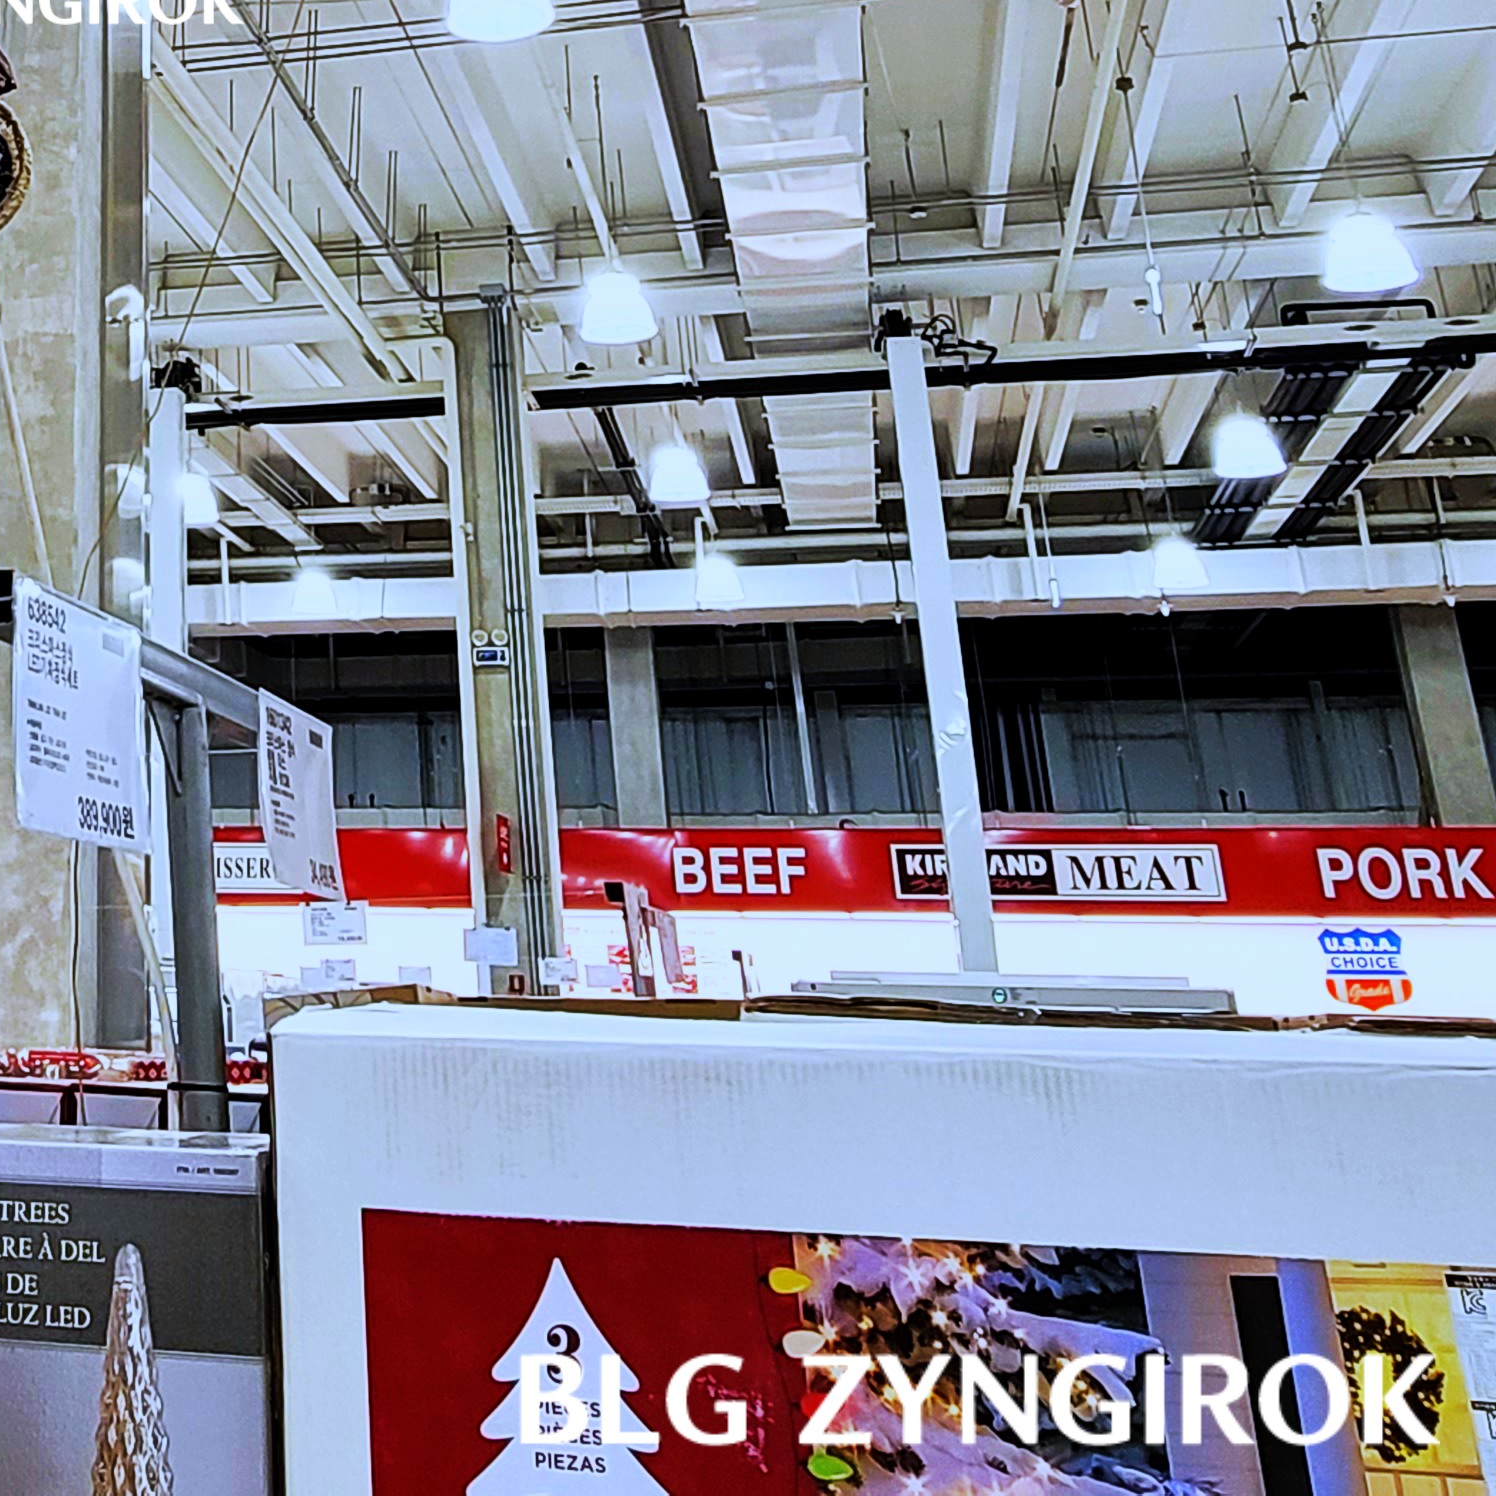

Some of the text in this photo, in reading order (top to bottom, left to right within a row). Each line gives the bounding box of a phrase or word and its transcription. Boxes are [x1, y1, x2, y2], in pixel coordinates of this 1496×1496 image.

[78, 796, 135, 839] 389,900원
[673, 847, 806, 894] BEEF
[906, 854, 1203, 891] KIRAND MEAT
[1316, 847, 1495, 900] PORK
[1324, 936, 1398, 952] U.S.D.A.
[1331, 956, 1399, 969] CHOICE
[1349, 980, 1391, 1002] Grade
[38, 1232, 53, 1260] À
[60, 1240, 105, 1263] DEL
[6, 1273, 38, 1296] DE
[44, 1305, 91, 1329] LED
[535, 1452, 607, 1473] PIEZAS
